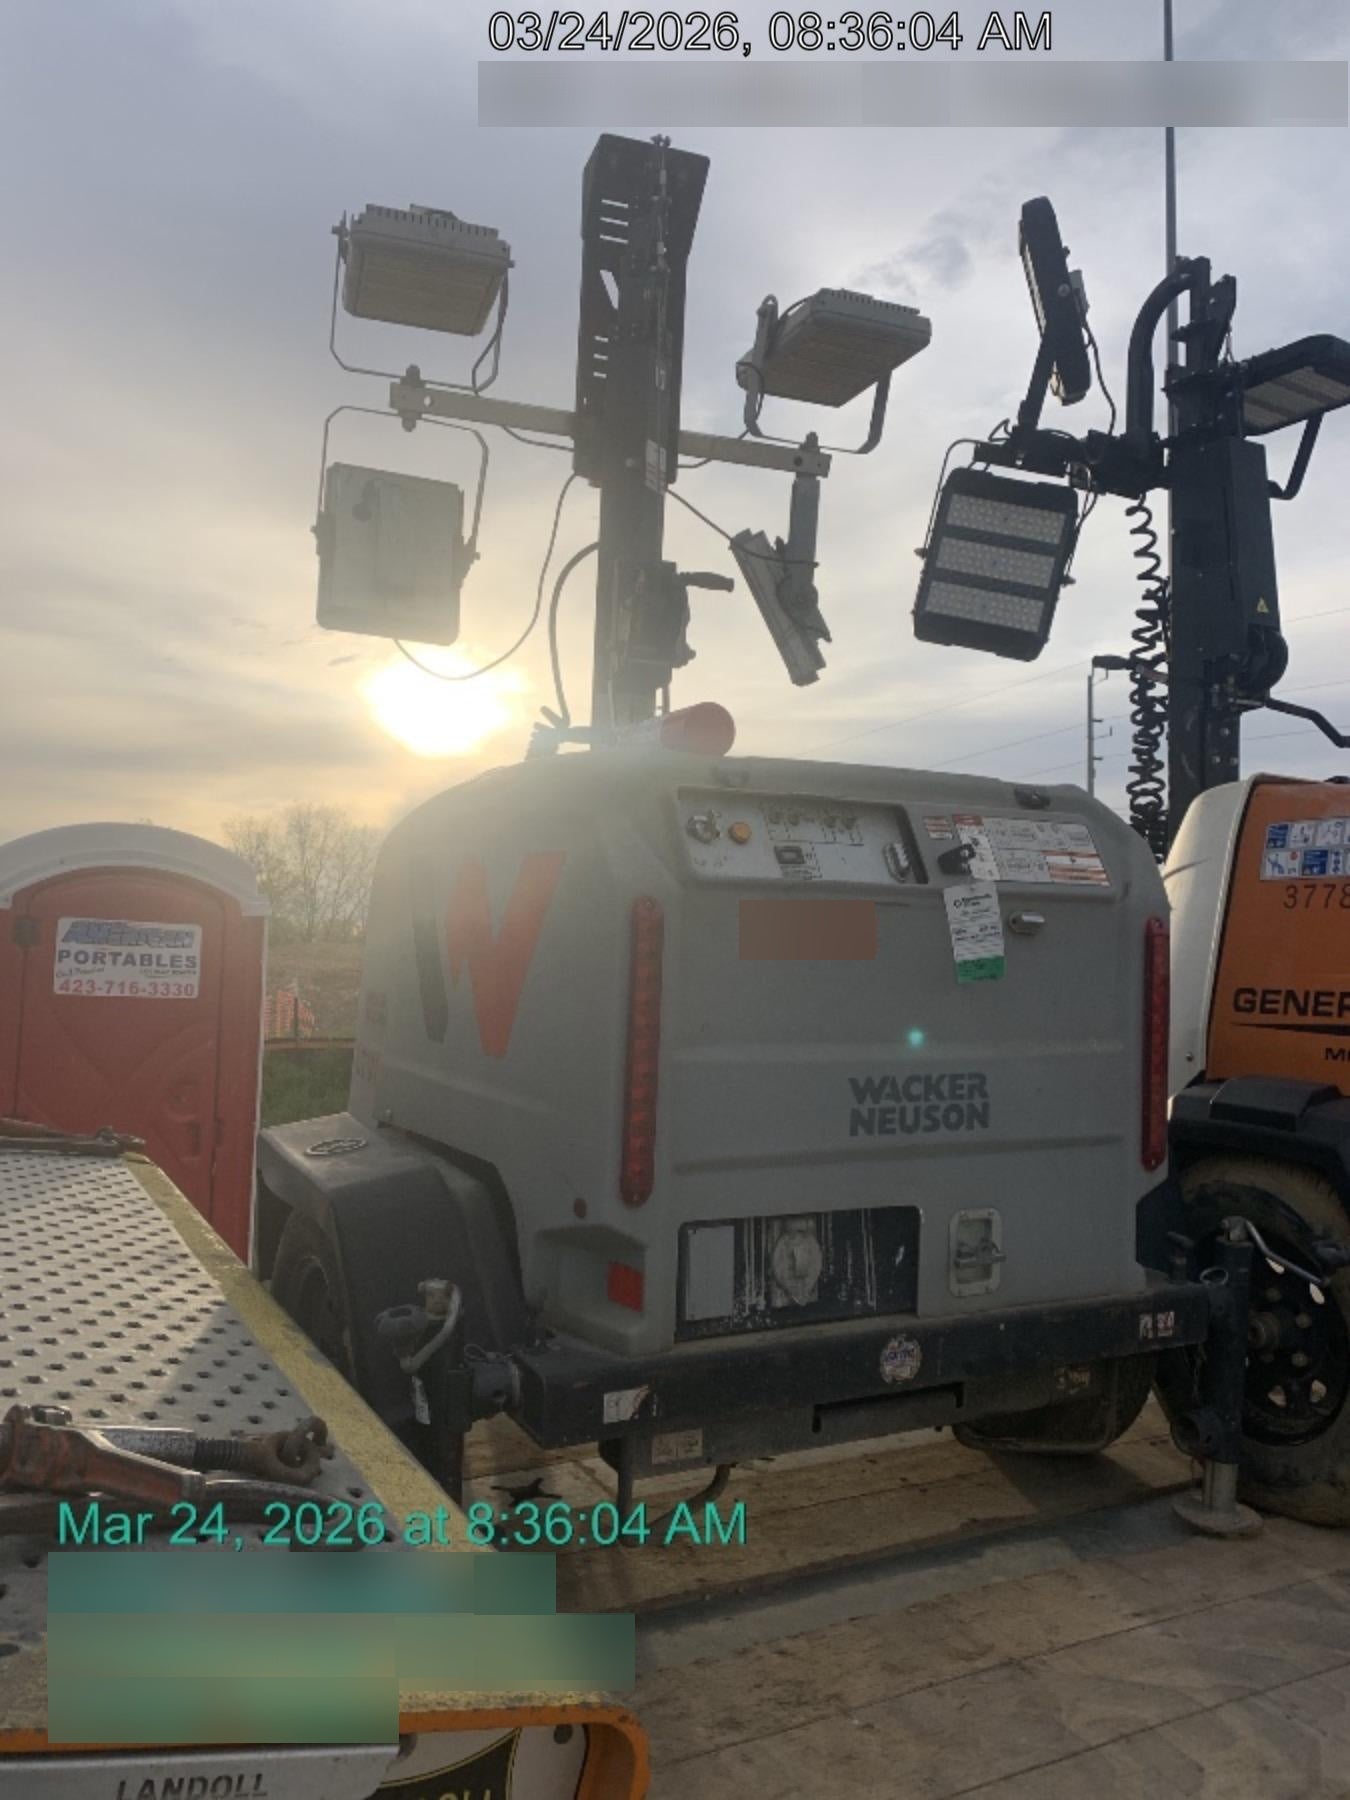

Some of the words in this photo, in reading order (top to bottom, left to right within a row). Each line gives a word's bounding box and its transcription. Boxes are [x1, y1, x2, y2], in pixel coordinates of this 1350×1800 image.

[57, 949, 198, 969] PORTABLES
[58, 979, 195, 997] 423-716-3330
[1325, 1047, 1350, 1062] M
[847, 1071, 989, 1105] WACKER
[848, 1101, 990, 1137] NEUSON
[116, 1773, 268, 1800] LANDOLL
